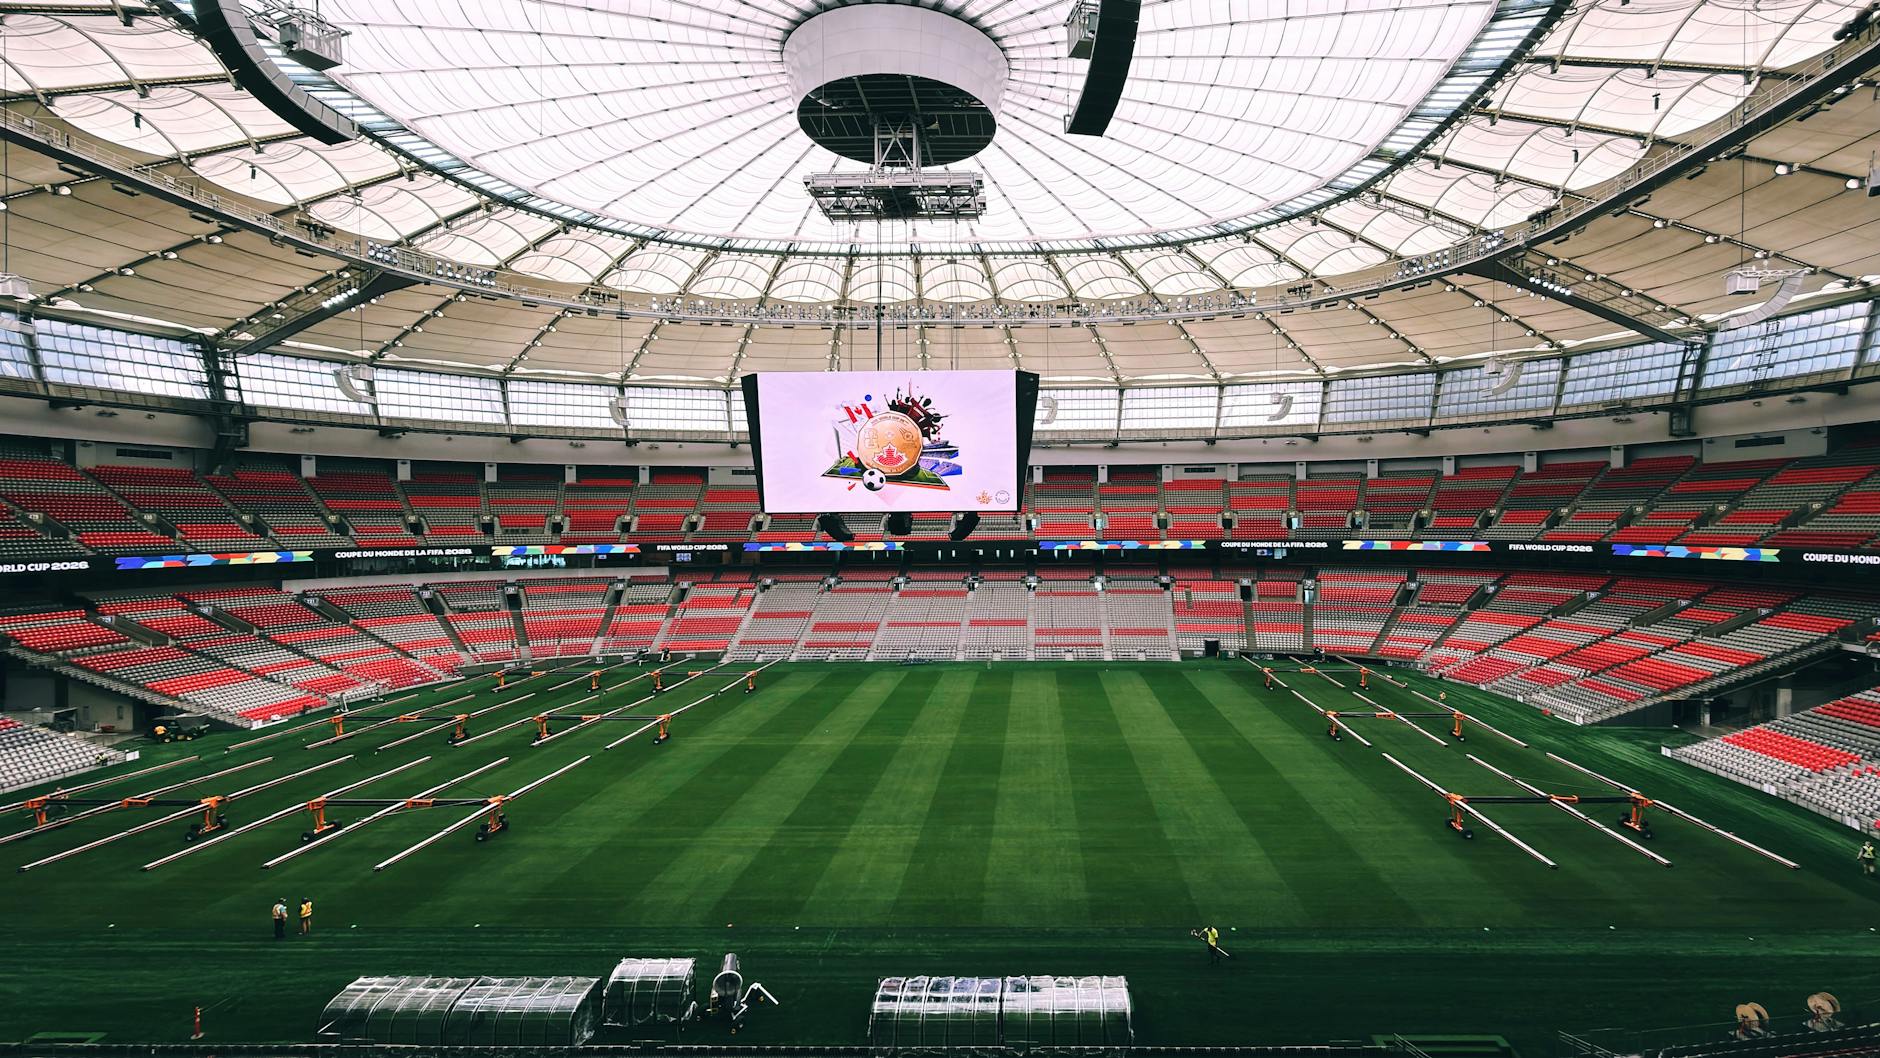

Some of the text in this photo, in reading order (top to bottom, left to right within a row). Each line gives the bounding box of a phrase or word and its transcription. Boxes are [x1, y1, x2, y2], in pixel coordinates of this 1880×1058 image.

[1525, 544, 1551, 552] WORLD
[1566, 545, 1594, 553] 2026
[335, 551, 362, 559] COUPE
[1803, 553, 1834, 562] COUPE
[1834, 554, 1849, 563] DU
[27, 563, 50, 571] CUP
[51, 561, 89, 570] 2026
